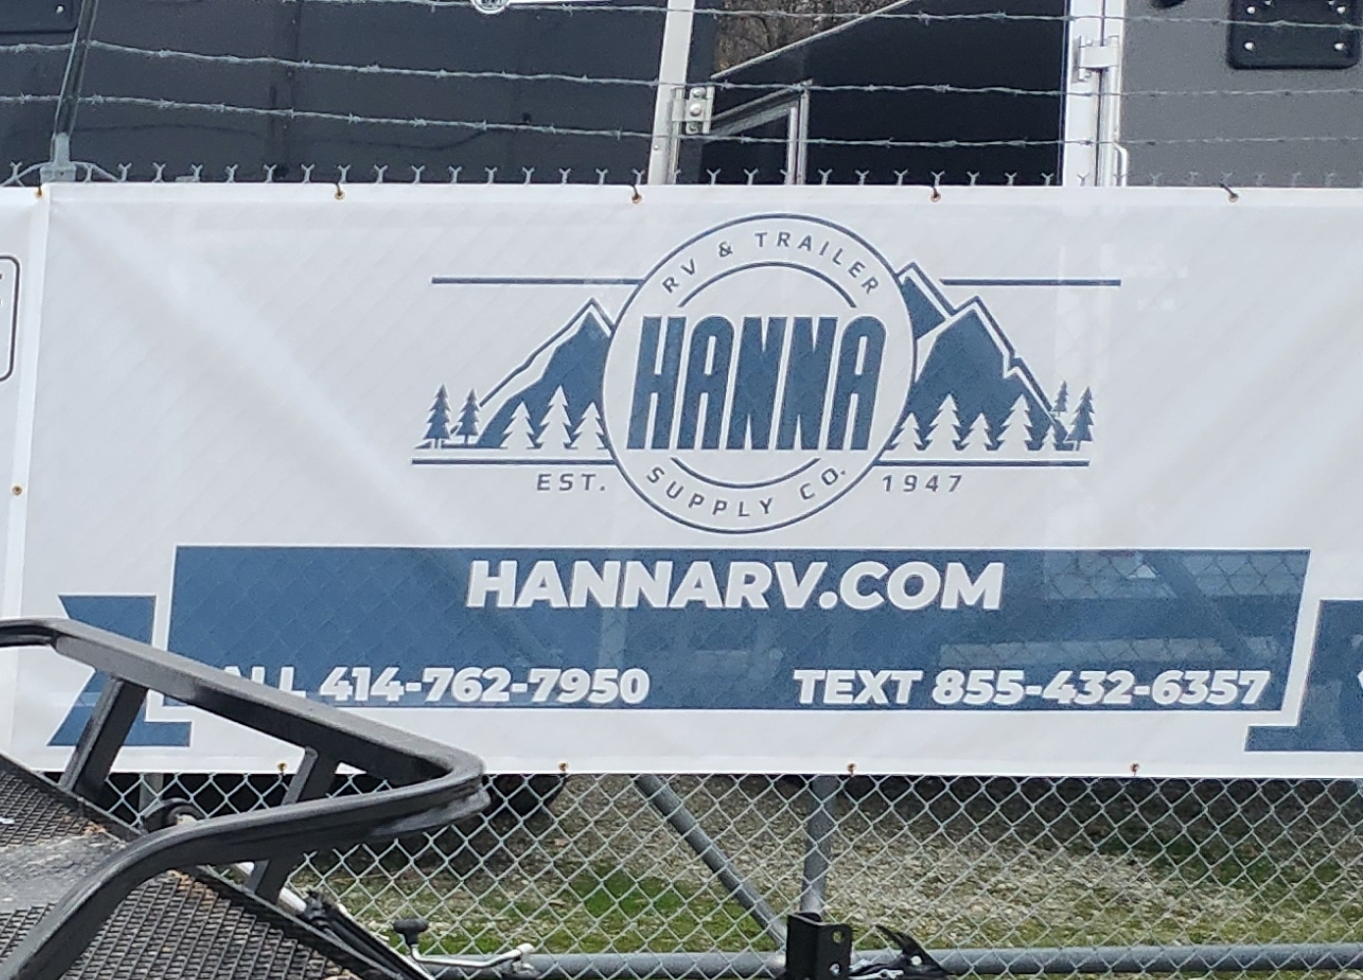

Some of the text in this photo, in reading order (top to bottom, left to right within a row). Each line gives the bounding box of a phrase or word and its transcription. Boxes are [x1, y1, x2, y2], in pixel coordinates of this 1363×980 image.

[661, 231, 880, 295] RV & TRAILER
[626, 315, 888, 451] HANNA
[535, 473, 608, 491] EST.
[646, 466, 847, 517] SUPPLY CO.
[881, 474, 963, 492] 1947
[466, 560, 1005, 611] HANNARV.COM
[319, 667, 650, 704] 414-762-7950
[793, 670, 1271, 705] TEXT 855-432-6357
